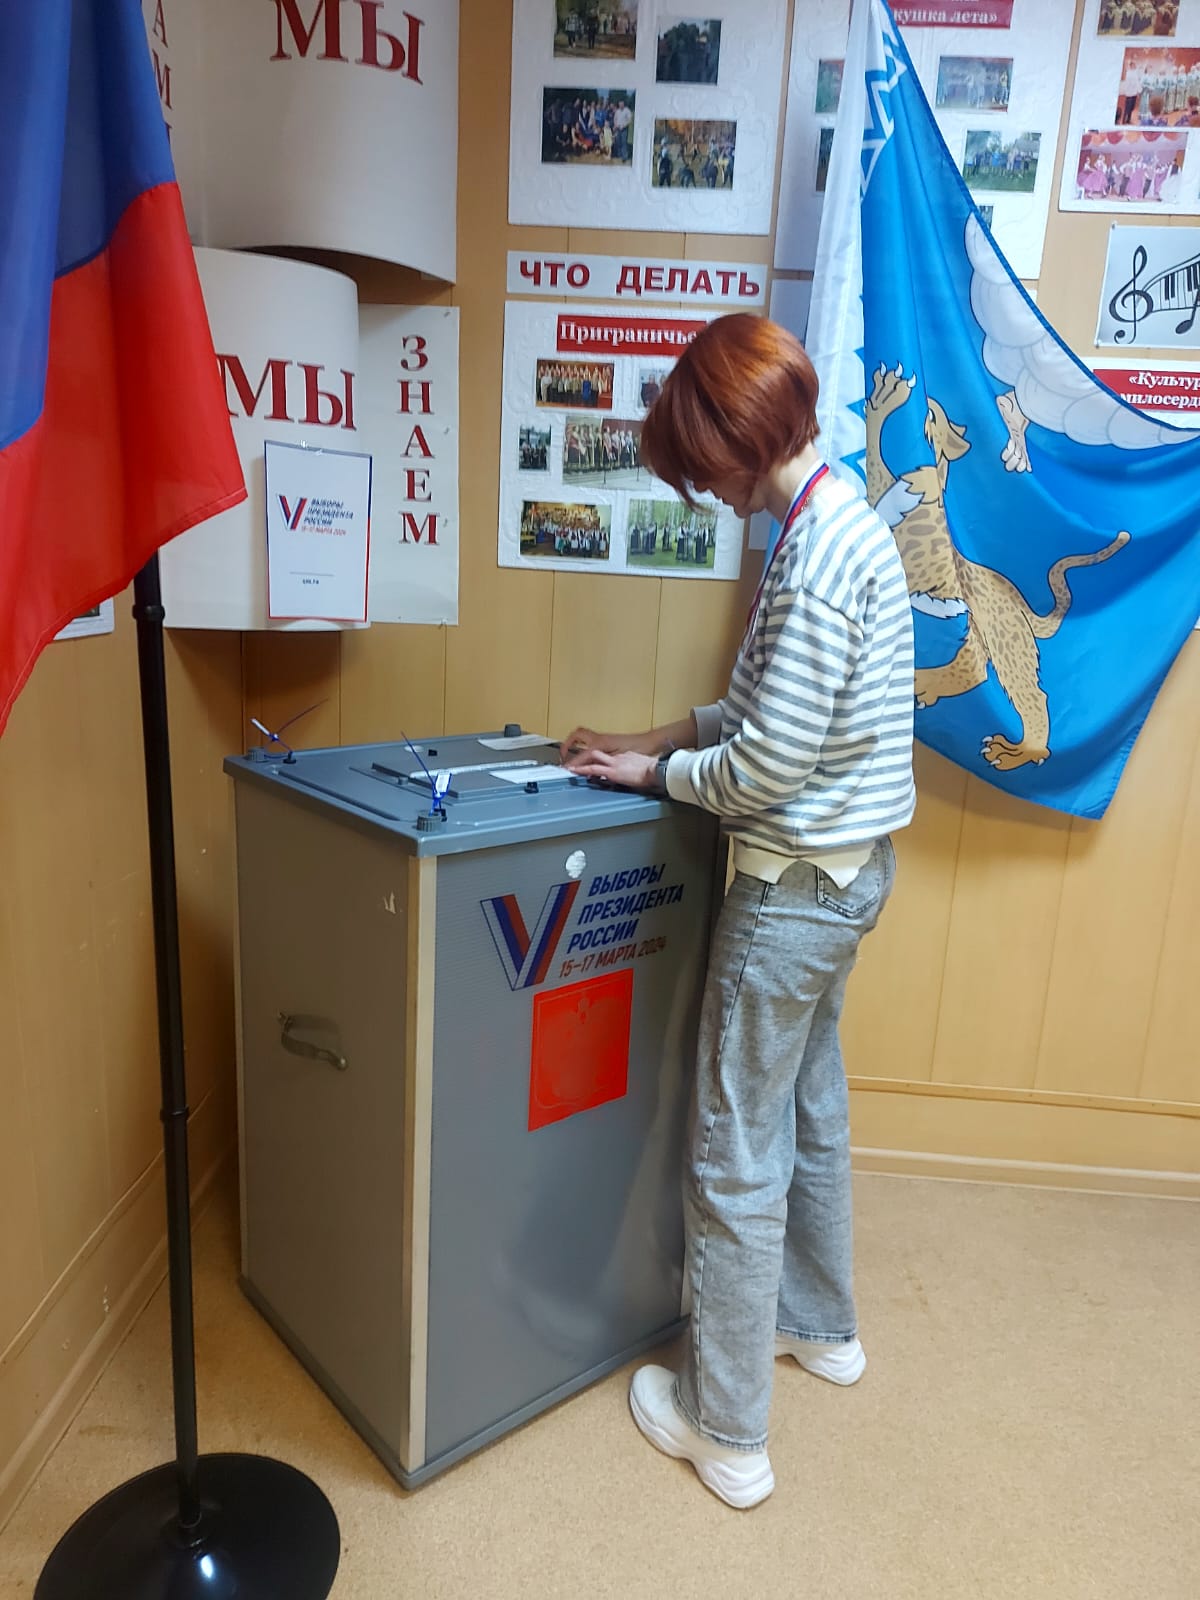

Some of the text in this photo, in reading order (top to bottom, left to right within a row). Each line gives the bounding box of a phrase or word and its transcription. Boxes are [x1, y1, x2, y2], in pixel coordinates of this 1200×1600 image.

[950, 10, 998, 25] лета»
[270, 0, 425, 86] МЫ
[520, 260, 761, 297] ЧТО ДЕЛАТЬ
[215, 353, 358, 432] МЫ
[396, 334, 441, 546] ЗНАЕМ
[587, 863, 666, 897] ВЫБОРЫ
[577, 884, 685, 926] ПРЕЗИДЕНТА
[566, 918, 640, 954] РОССИИ
[594, 943, 638, 969] МАРТА
[637, 935, 668, 957] 2024
